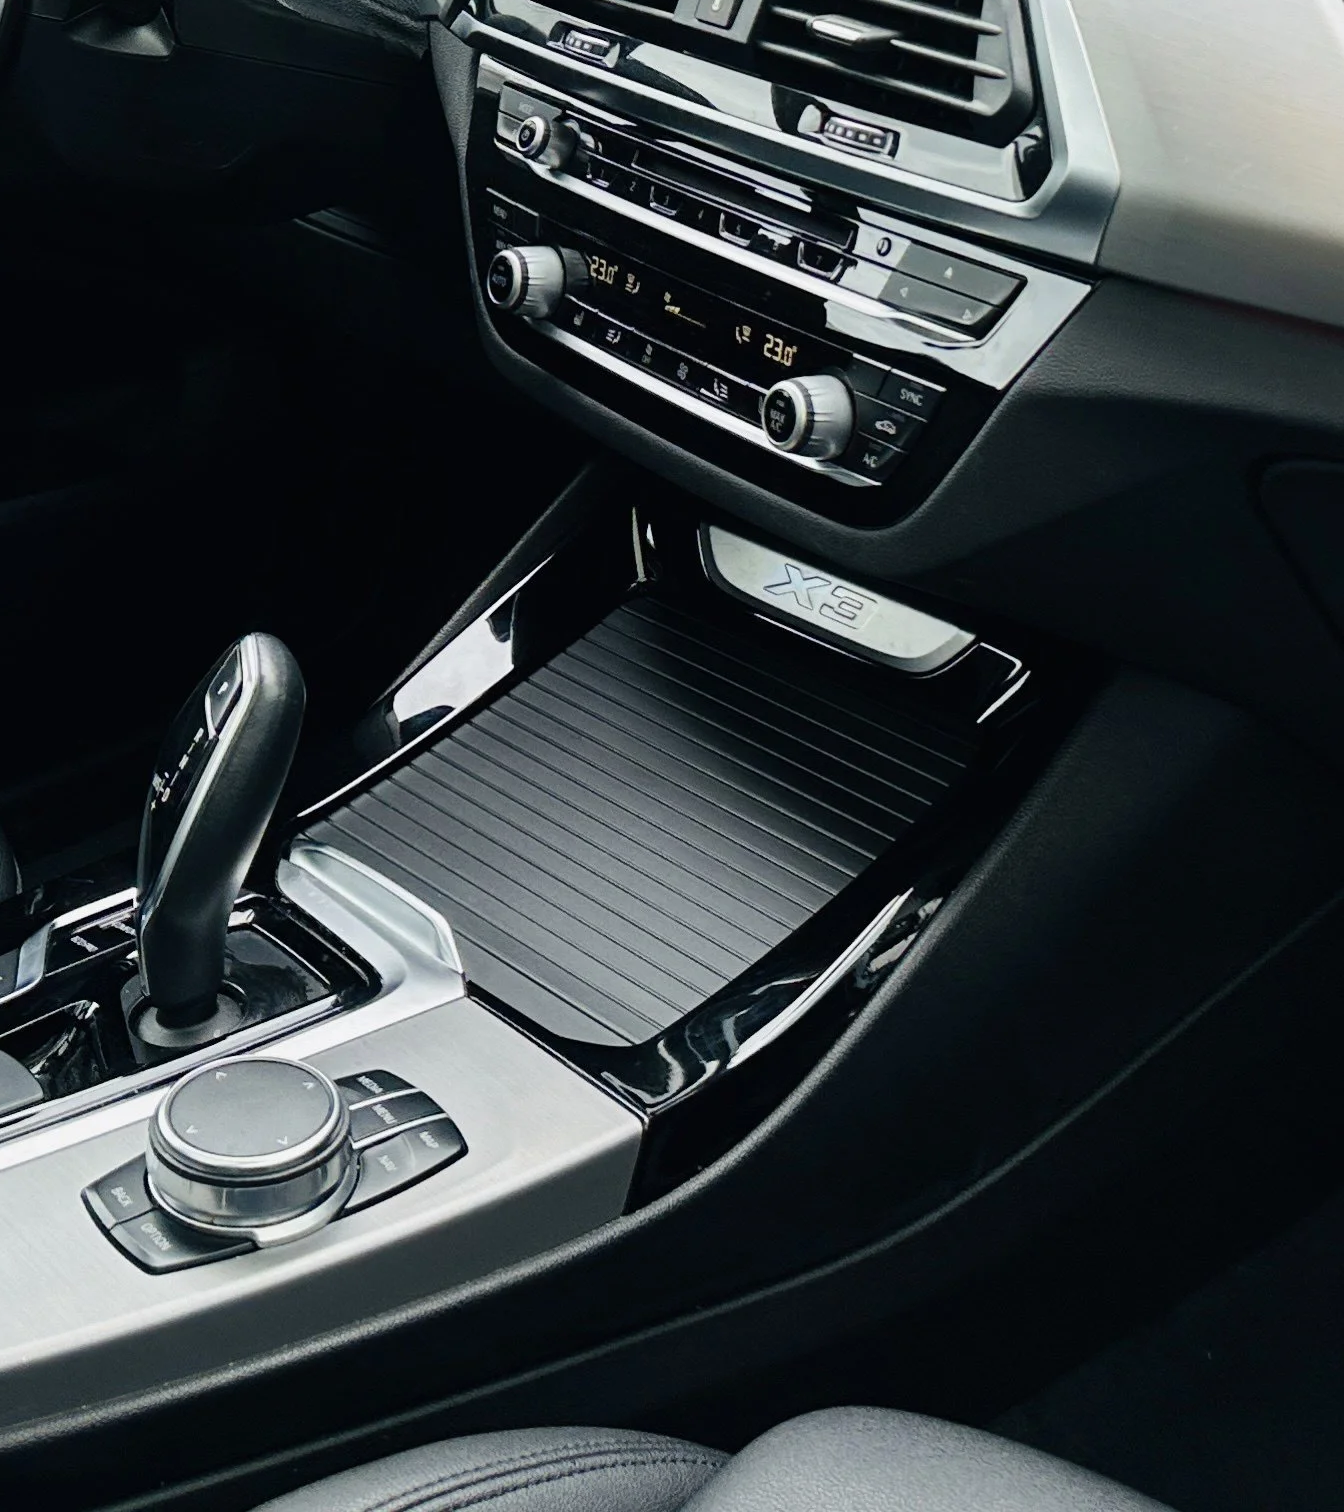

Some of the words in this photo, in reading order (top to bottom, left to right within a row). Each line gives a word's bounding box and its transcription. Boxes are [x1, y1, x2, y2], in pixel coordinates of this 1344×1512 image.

[899, 388, 924, 407] SYNC
[862, 452, 879, 468] A/C
[763, 563, 878, 630] X3
[372, 1103, 397, 1125] MENU
